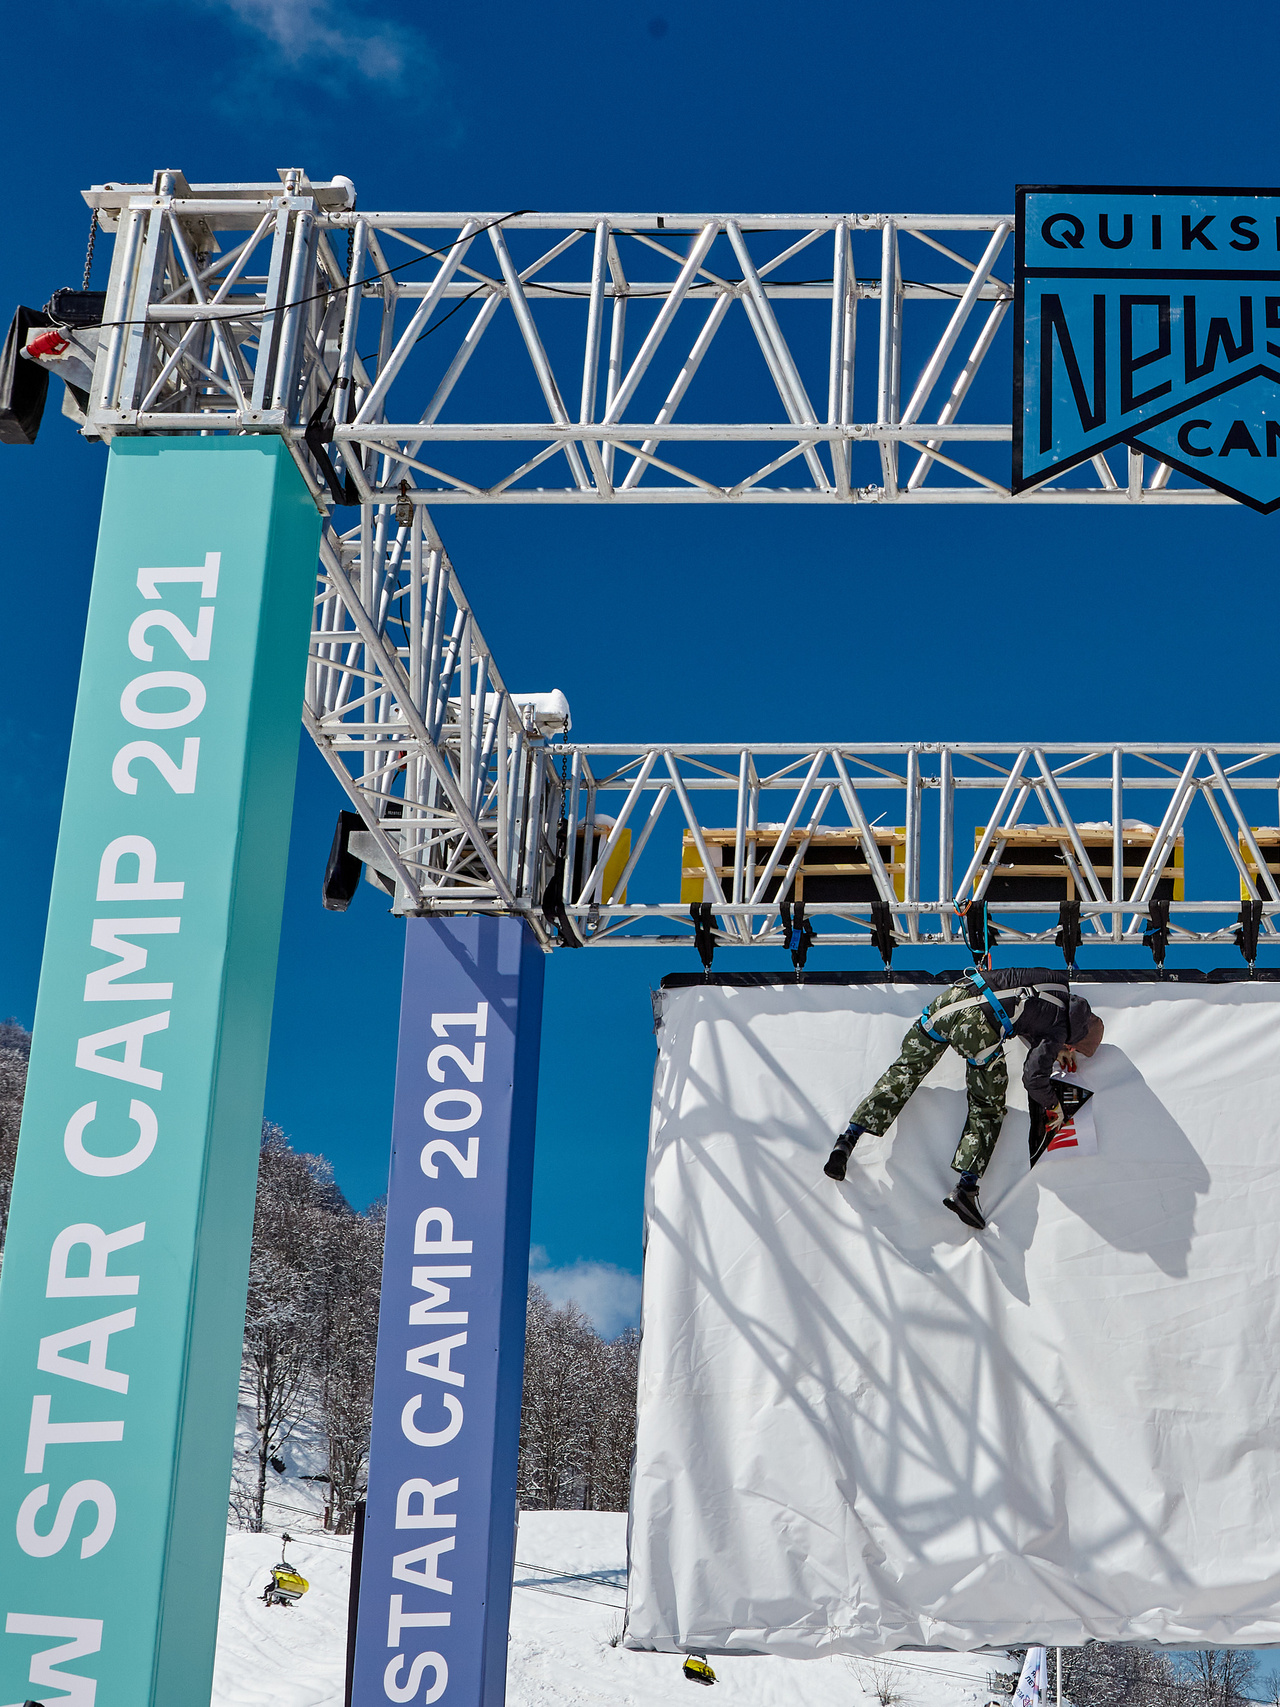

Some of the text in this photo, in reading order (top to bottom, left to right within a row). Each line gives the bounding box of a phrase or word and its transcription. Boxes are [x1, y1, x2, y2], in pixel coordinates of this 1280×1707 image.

[112, 552, 222, 795] 2021
[63, 835, 185, 1177] CAMP
[16, 1221, 146, 1560] STAR
[383, 1002, 489, 1705] STAR CAMP 2021
